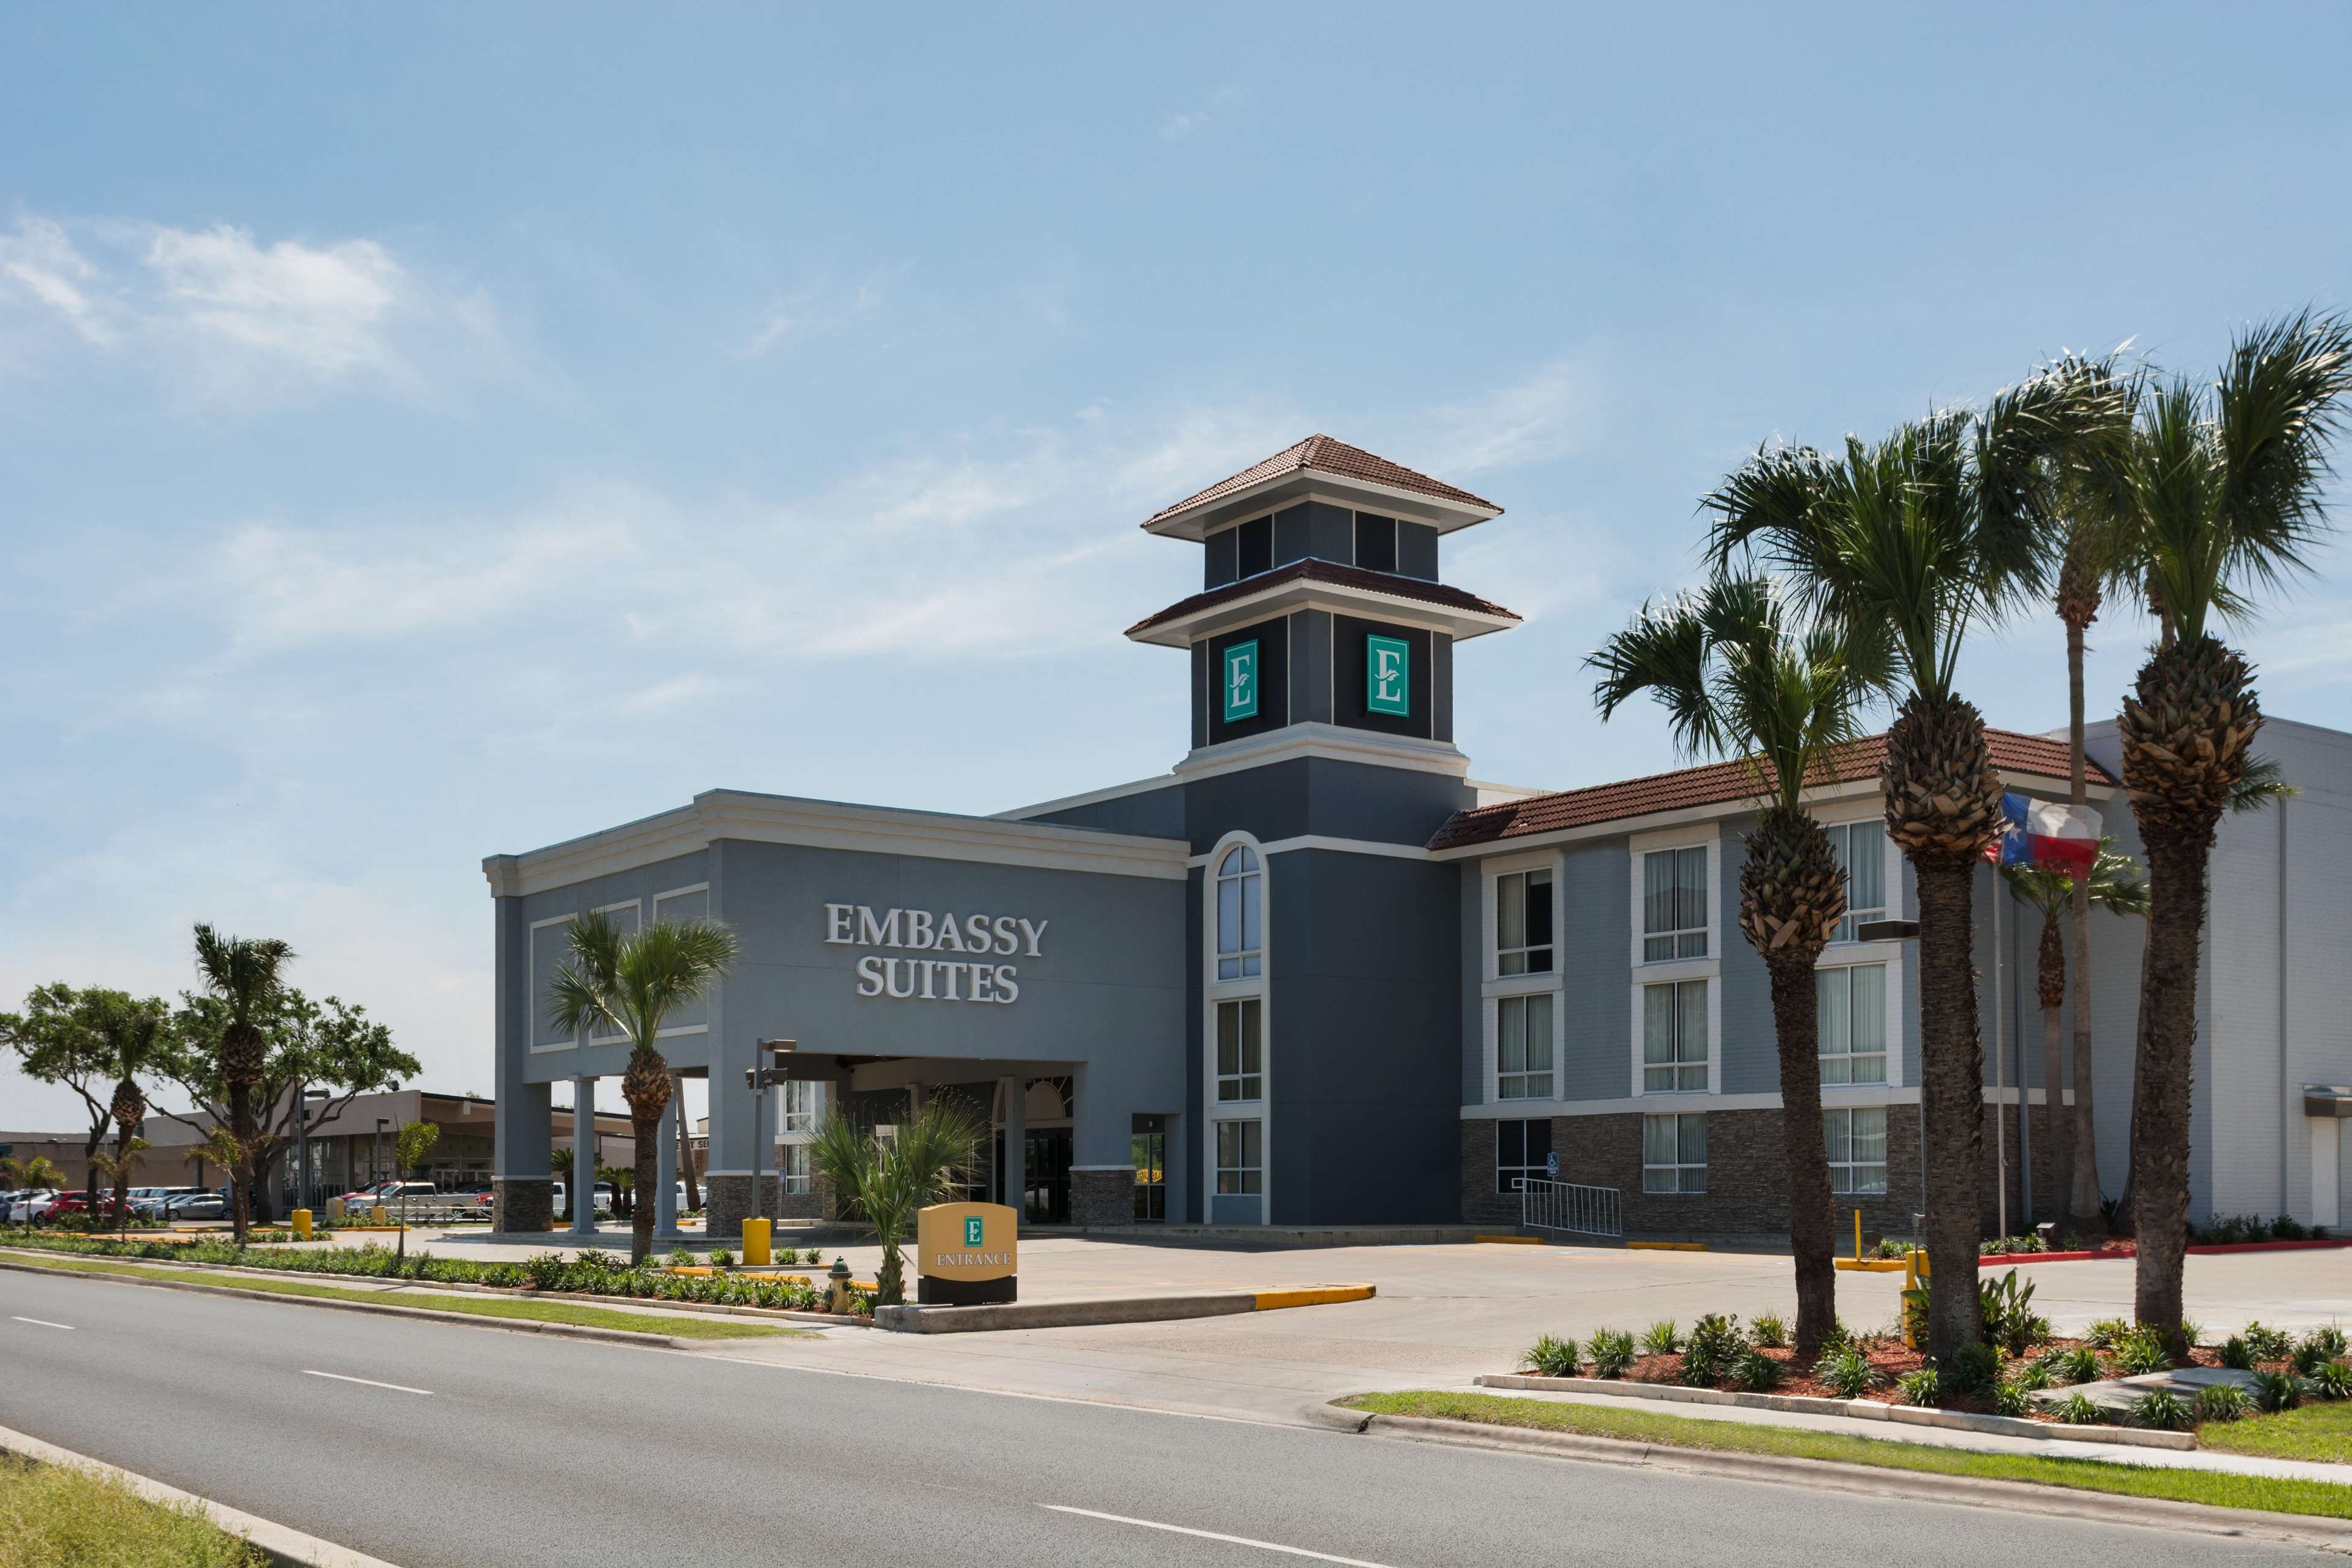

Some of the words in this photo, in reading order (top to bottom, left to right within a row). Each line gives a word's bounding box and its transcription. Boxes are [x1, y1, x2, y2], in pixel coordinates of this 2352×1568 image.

[1230, 655, 1250, 707] E
[1374, 649, 1400, 702] E
[824, 903, 1049, 957] EMBASSY
[856, 956, 1019, 1004] SUITES
[968, 1221, 980, 1242] E
[937, 1253, 1010, 1267] ENTRANCE
